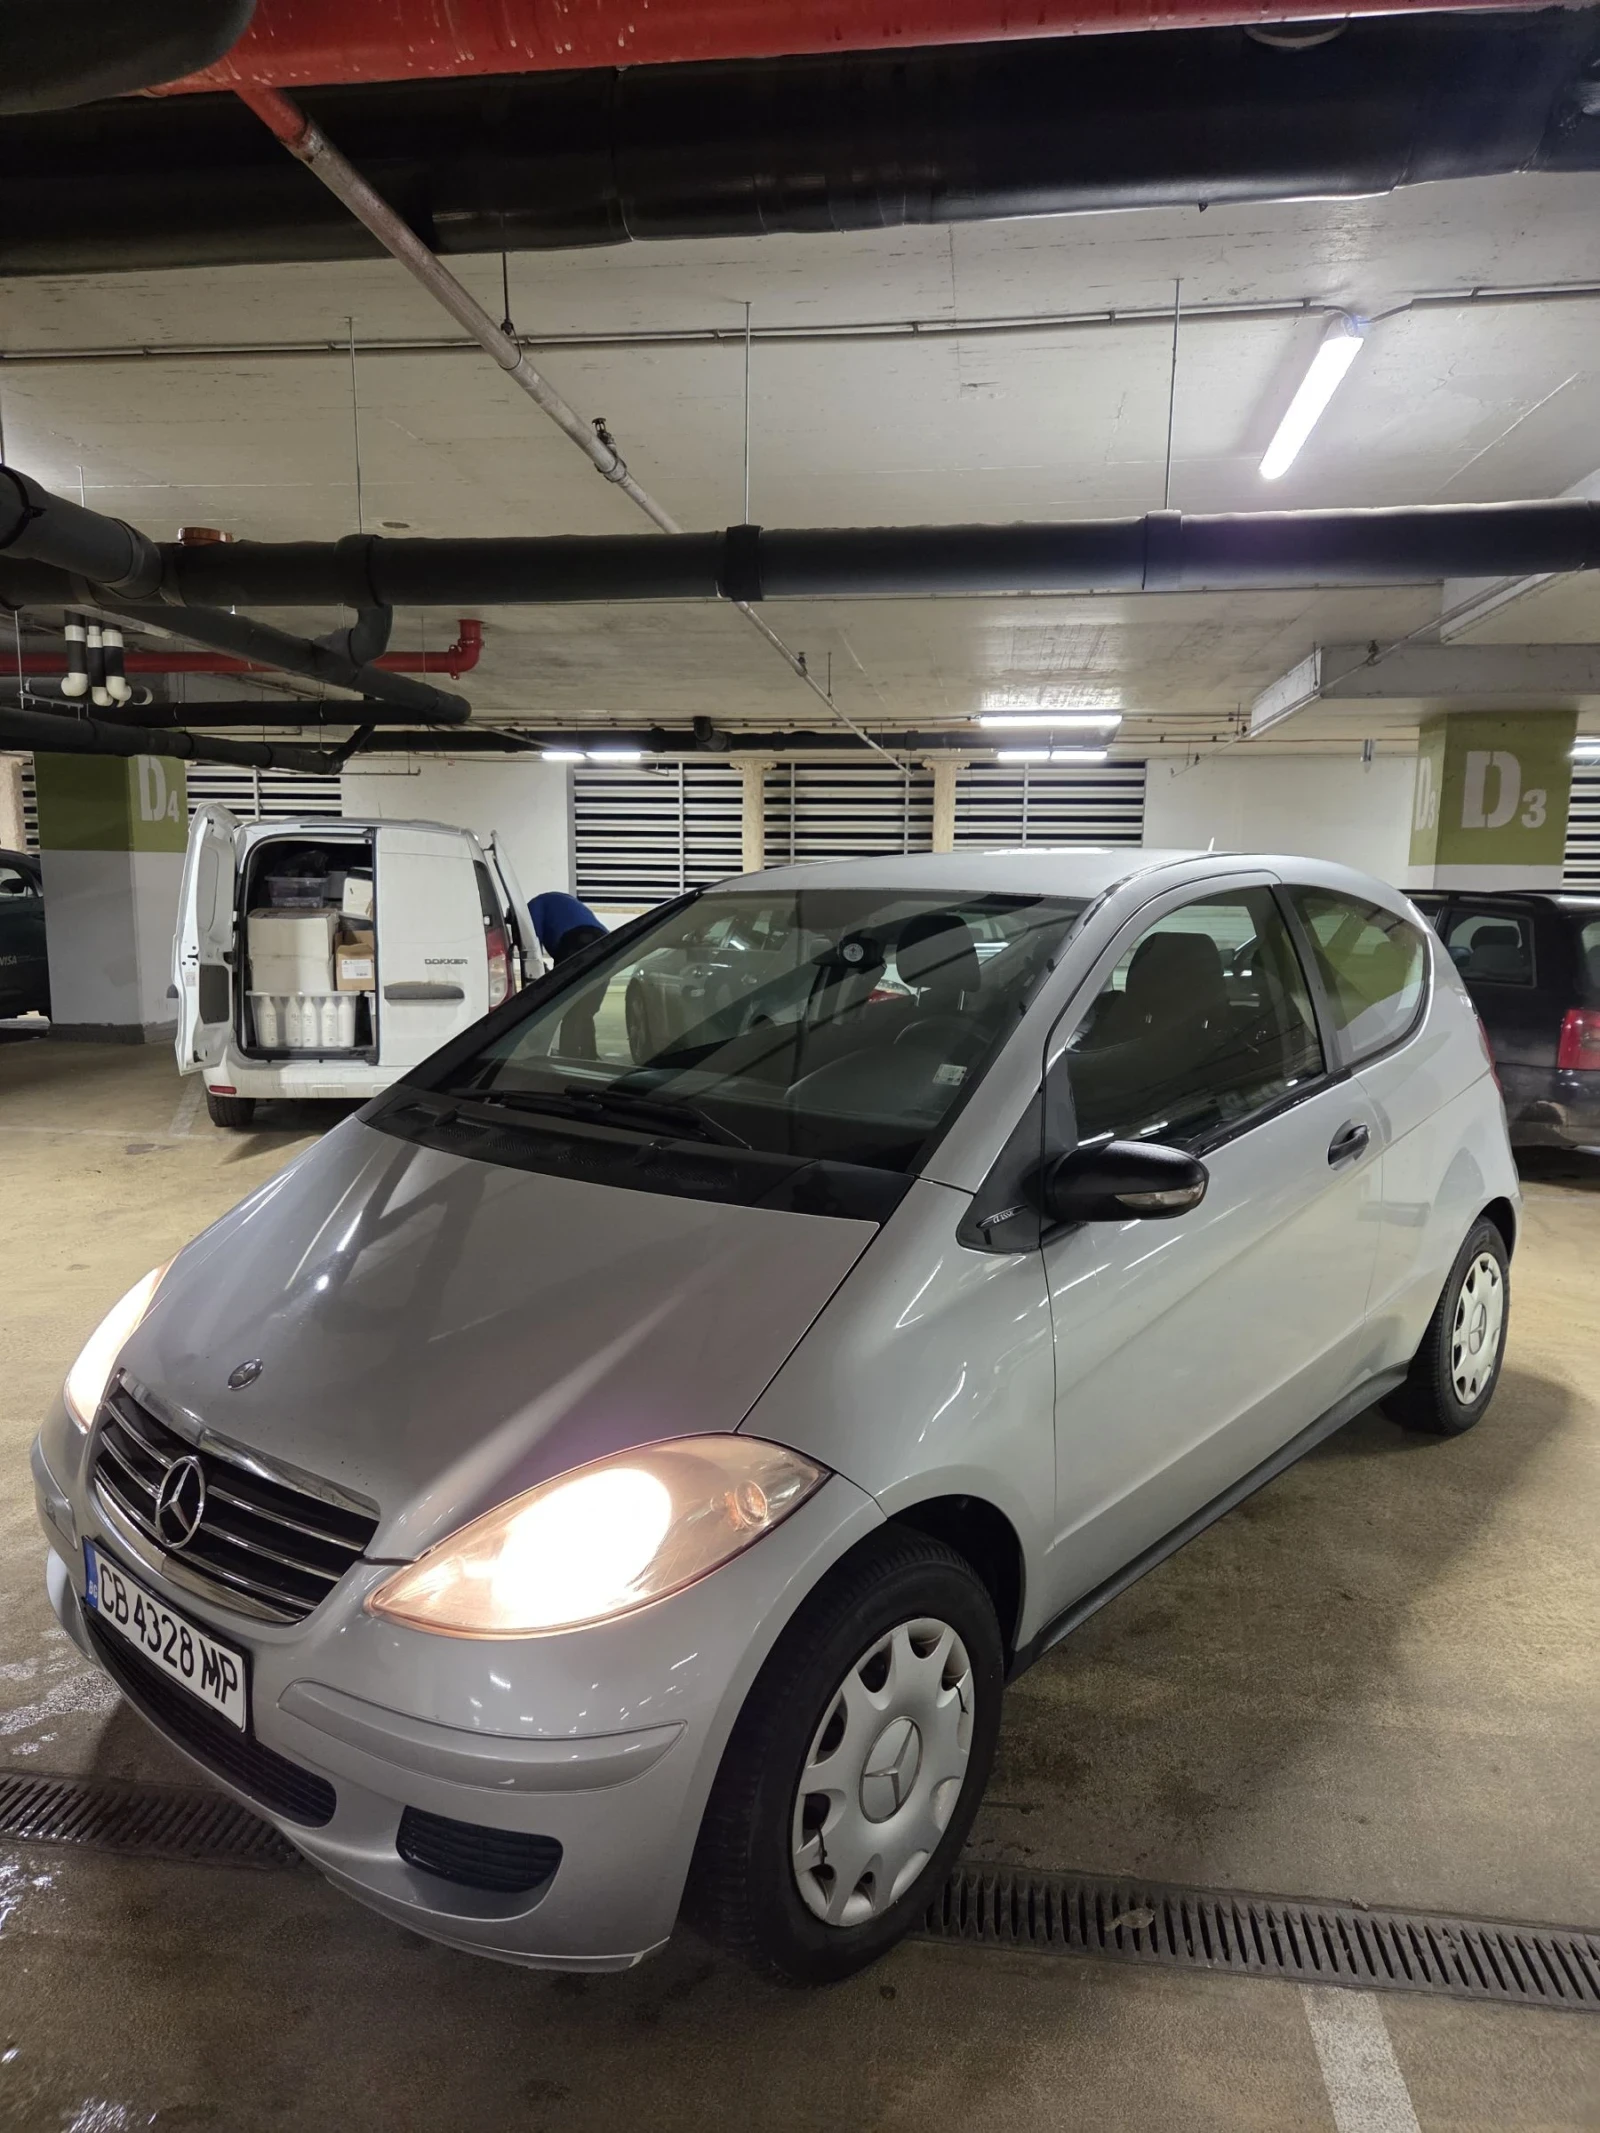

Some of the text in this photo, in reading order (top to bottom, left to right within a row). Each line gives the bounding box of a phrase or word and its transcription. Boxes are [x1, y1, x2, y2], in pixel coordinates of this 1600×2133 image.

[137, 755, 180, 823] D4
[1461, 750, 1547, 829] D3
[88, 1580, 99, 1599] BG
[100, 1563, 238, 1704] CB 4328 MP
